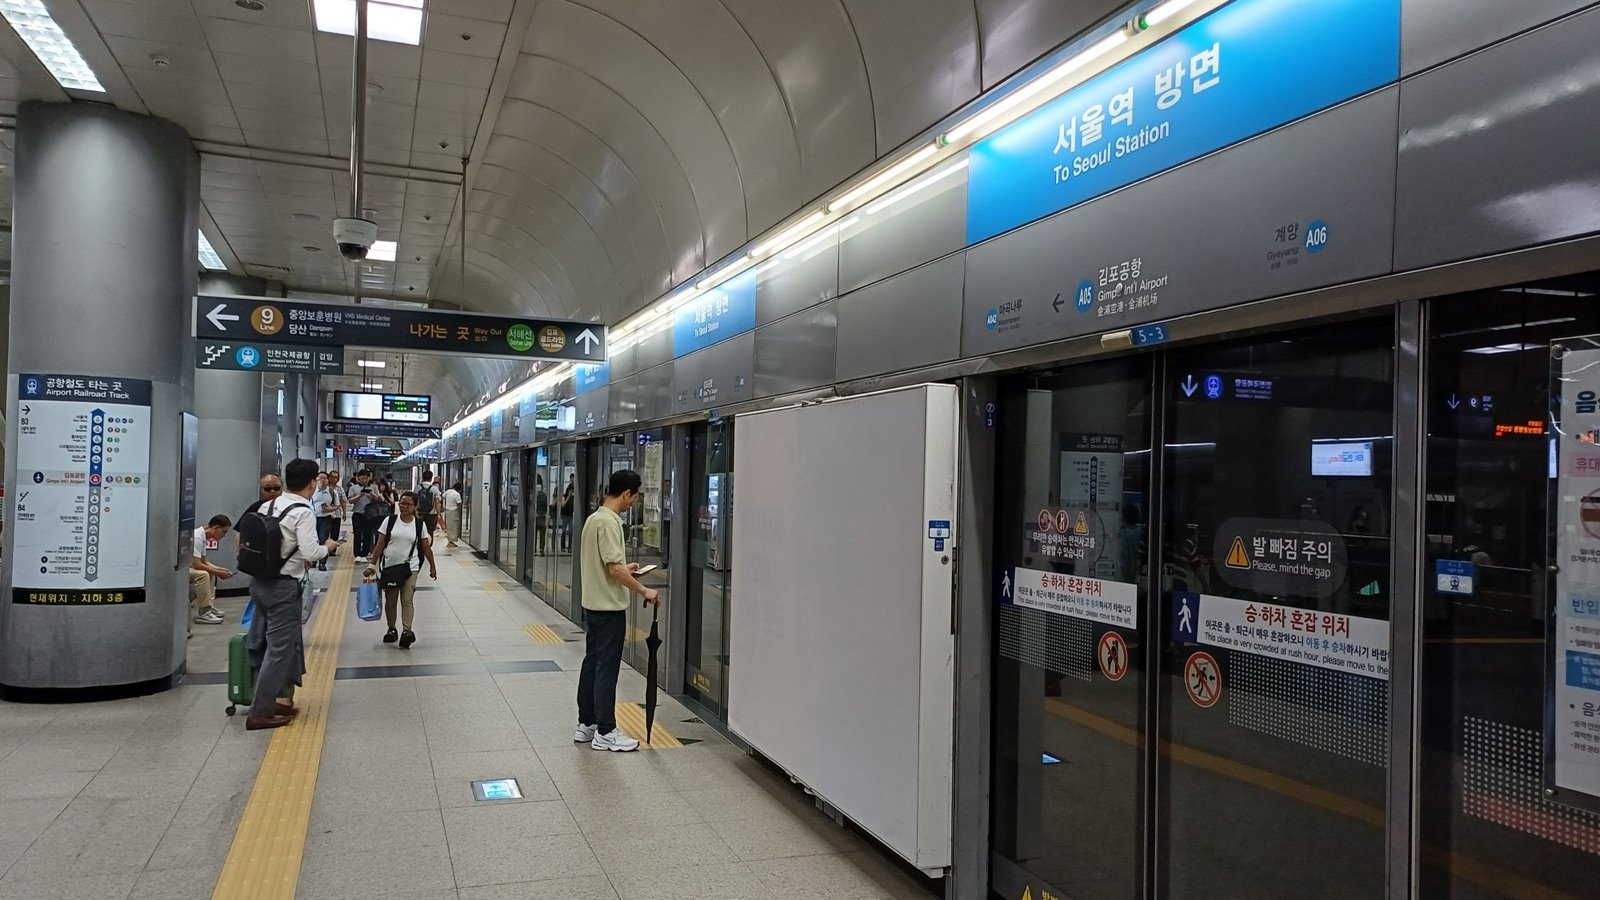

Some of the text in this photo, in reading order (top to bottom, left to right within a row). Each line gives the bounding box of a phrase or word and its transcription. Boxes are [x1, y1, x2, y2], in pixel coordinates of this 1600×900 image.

[1053, 42, 1220, 155] 서울역 방면
[1053, 120, 1170, 184] To Seoul Station
[1274, 222, 1299, 243] 계양
[1305, 226, 1327, 247] A06
[1267, 247, 1299, 260] Gyeyang
[1098, 257, 1142, 286] 김포공항
[1124, 280, 1137, 295] Int'l
[1139, 275, 1168, 291] Airport
[1078, 286, 1092, 306] A05
[999, 299, 1022, 315] 마곡나루
[261, 308, 274, 324] 9
[289, 309, 342, 323] 중앙보훈병원
[289, 324, 308, 335] 당산
[309, 325, 334, 333] Dangsan
[410, 323, 470, 340] 나가는 곳
[474, 327, 489, 335] Way
[508, 329, 533, 341] 서해선
[540, 335, 565, 344] 골드라인
[266, 350, 311, 360] 인천국제공항
[46, 378, 122, 392] 공항철도 타는 곳
[74, 389, 106, 398] Railroad
[109, 391, 130, 399] Track
[1068, 536, 1095, 548] 안전사고를
[1252, 536, 1332, 563] 발 빠짐 주의
[1057, 547, 1063, 557] 수
[1063, 547, 1084, 559] 있습니다
[1252, 559, 1331, 579] Please, mind the gap
[1067, 578, 1083, 593] 혼잡
[1086, 580, 1102, 597] 위치
[29, 593, 68, 603] 현재위치
[81, 592, 102, 603] 지하
[107, 592, 124, 603] 3층
[1066, 605, 1074, 613] rush
[1099, 612, 1110, 620] move
[1113, 603, 1132, 615] 바랍니다
[1572, 599, 1599, 614] 반입
[1245, 604, 1350, 638] 승·하차 혼잡 위치
[1205, 620, 1223, 632] 이곳은
[1255, 627, 1269, 639] 매우
[1270, 630, 1304, 647] 혼잡하오니
[1306, 638, 1320, 650] 이동
[1322, 640, 1330, 650] 후
[1331, 642, 1369, 658] 승차하시기
[1204, 632, 1389, 675] This place is very crowded at rush hour, please move to the
